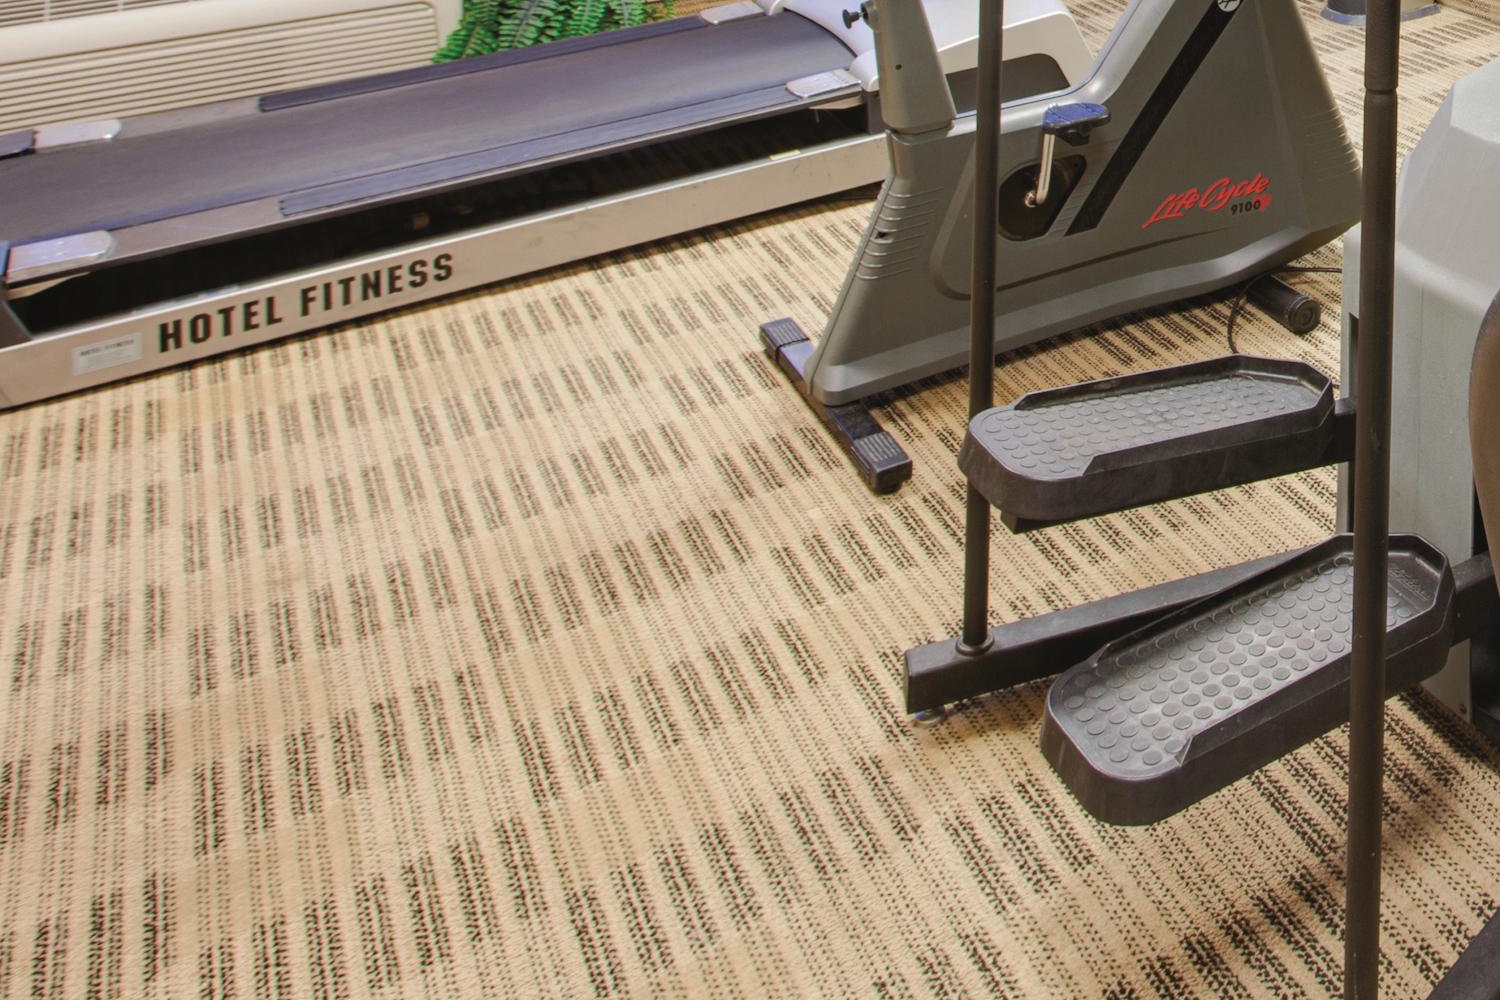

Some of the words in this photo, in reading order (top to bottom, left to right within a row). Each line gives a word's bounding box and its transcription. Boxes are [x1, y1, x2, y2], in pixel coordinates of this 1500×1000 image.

[1231, 199, 1262, 215] 9100
[158, 297, 283, 353] HOTEL
[300, 253, 454, 317] FITNESS
